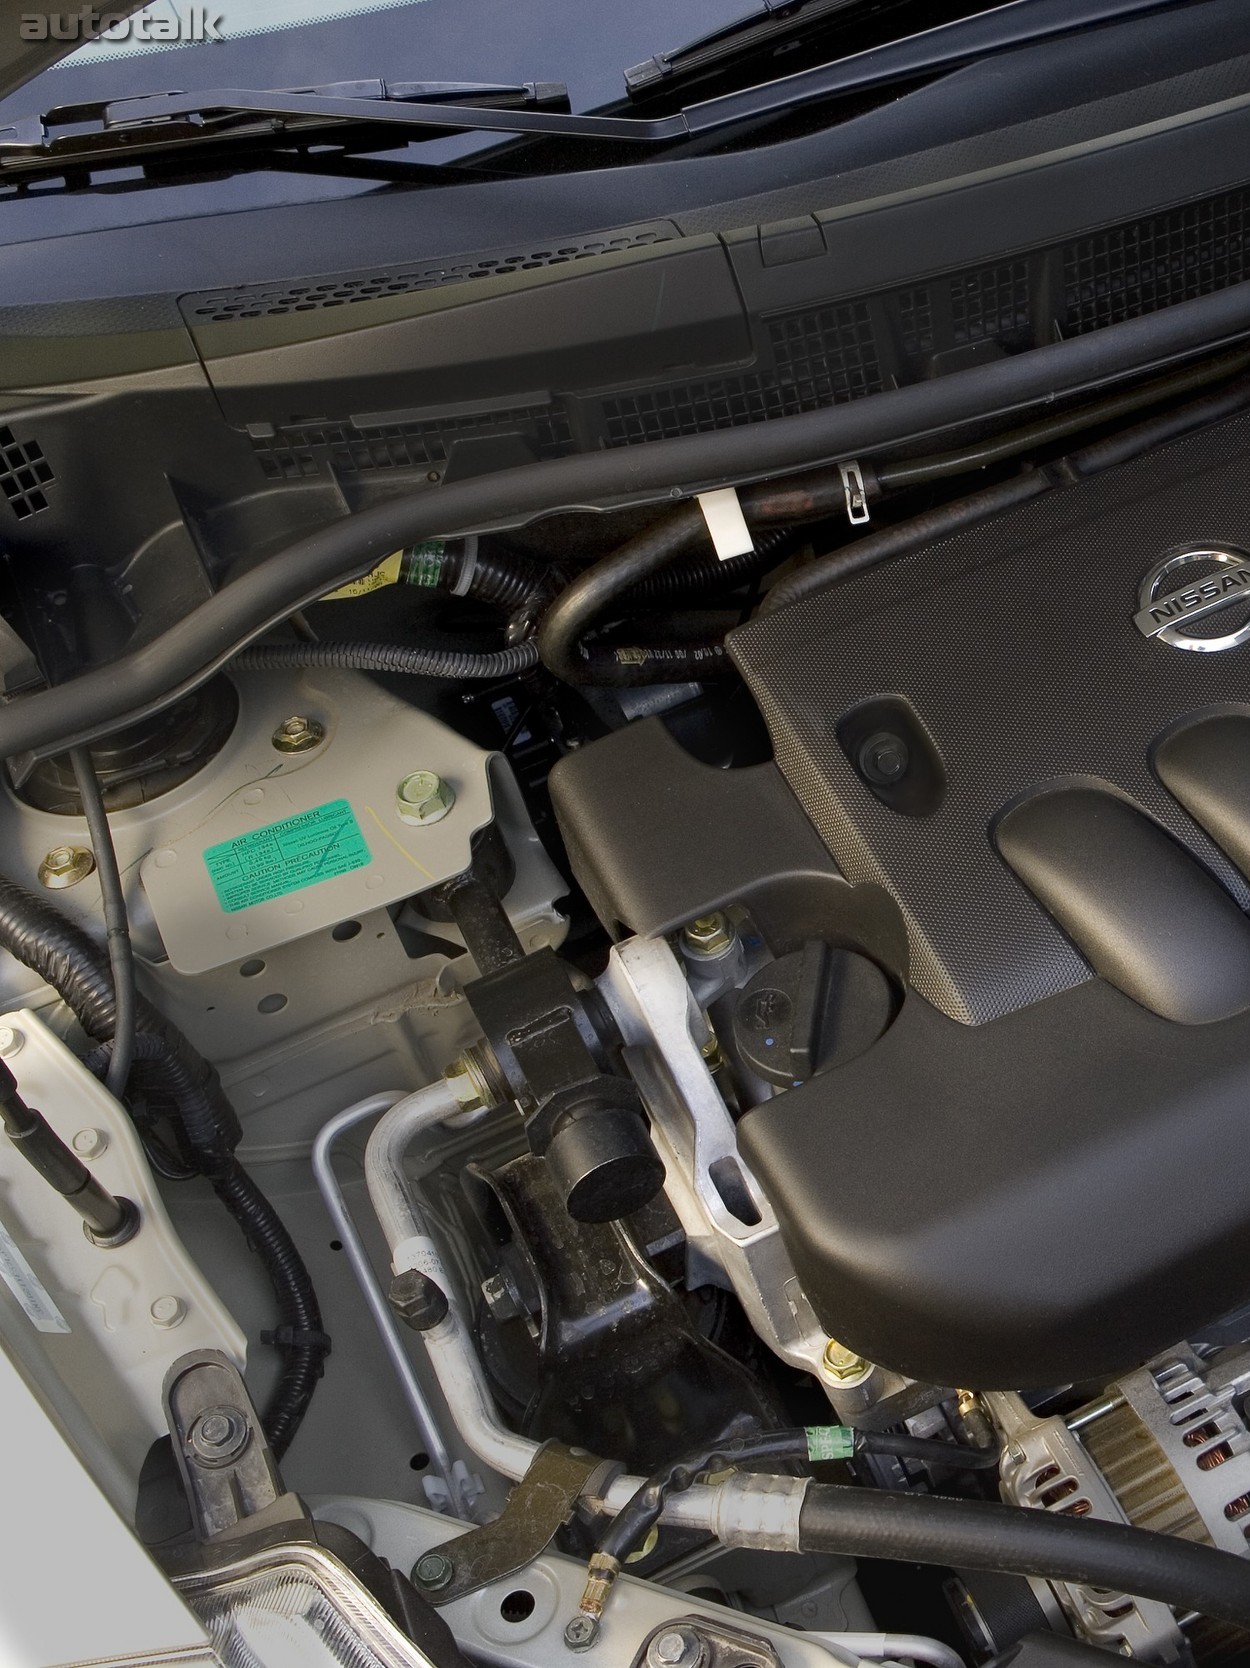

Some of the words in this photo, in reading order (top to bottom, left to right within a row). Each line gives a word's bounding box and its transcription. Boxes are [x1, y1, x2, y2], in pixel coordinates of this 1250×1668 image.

[230, 837, 248, 849] AIR
[250, 809, 321, 841] CONDITIONER
[241, 863, 281, 882] CAUTION
